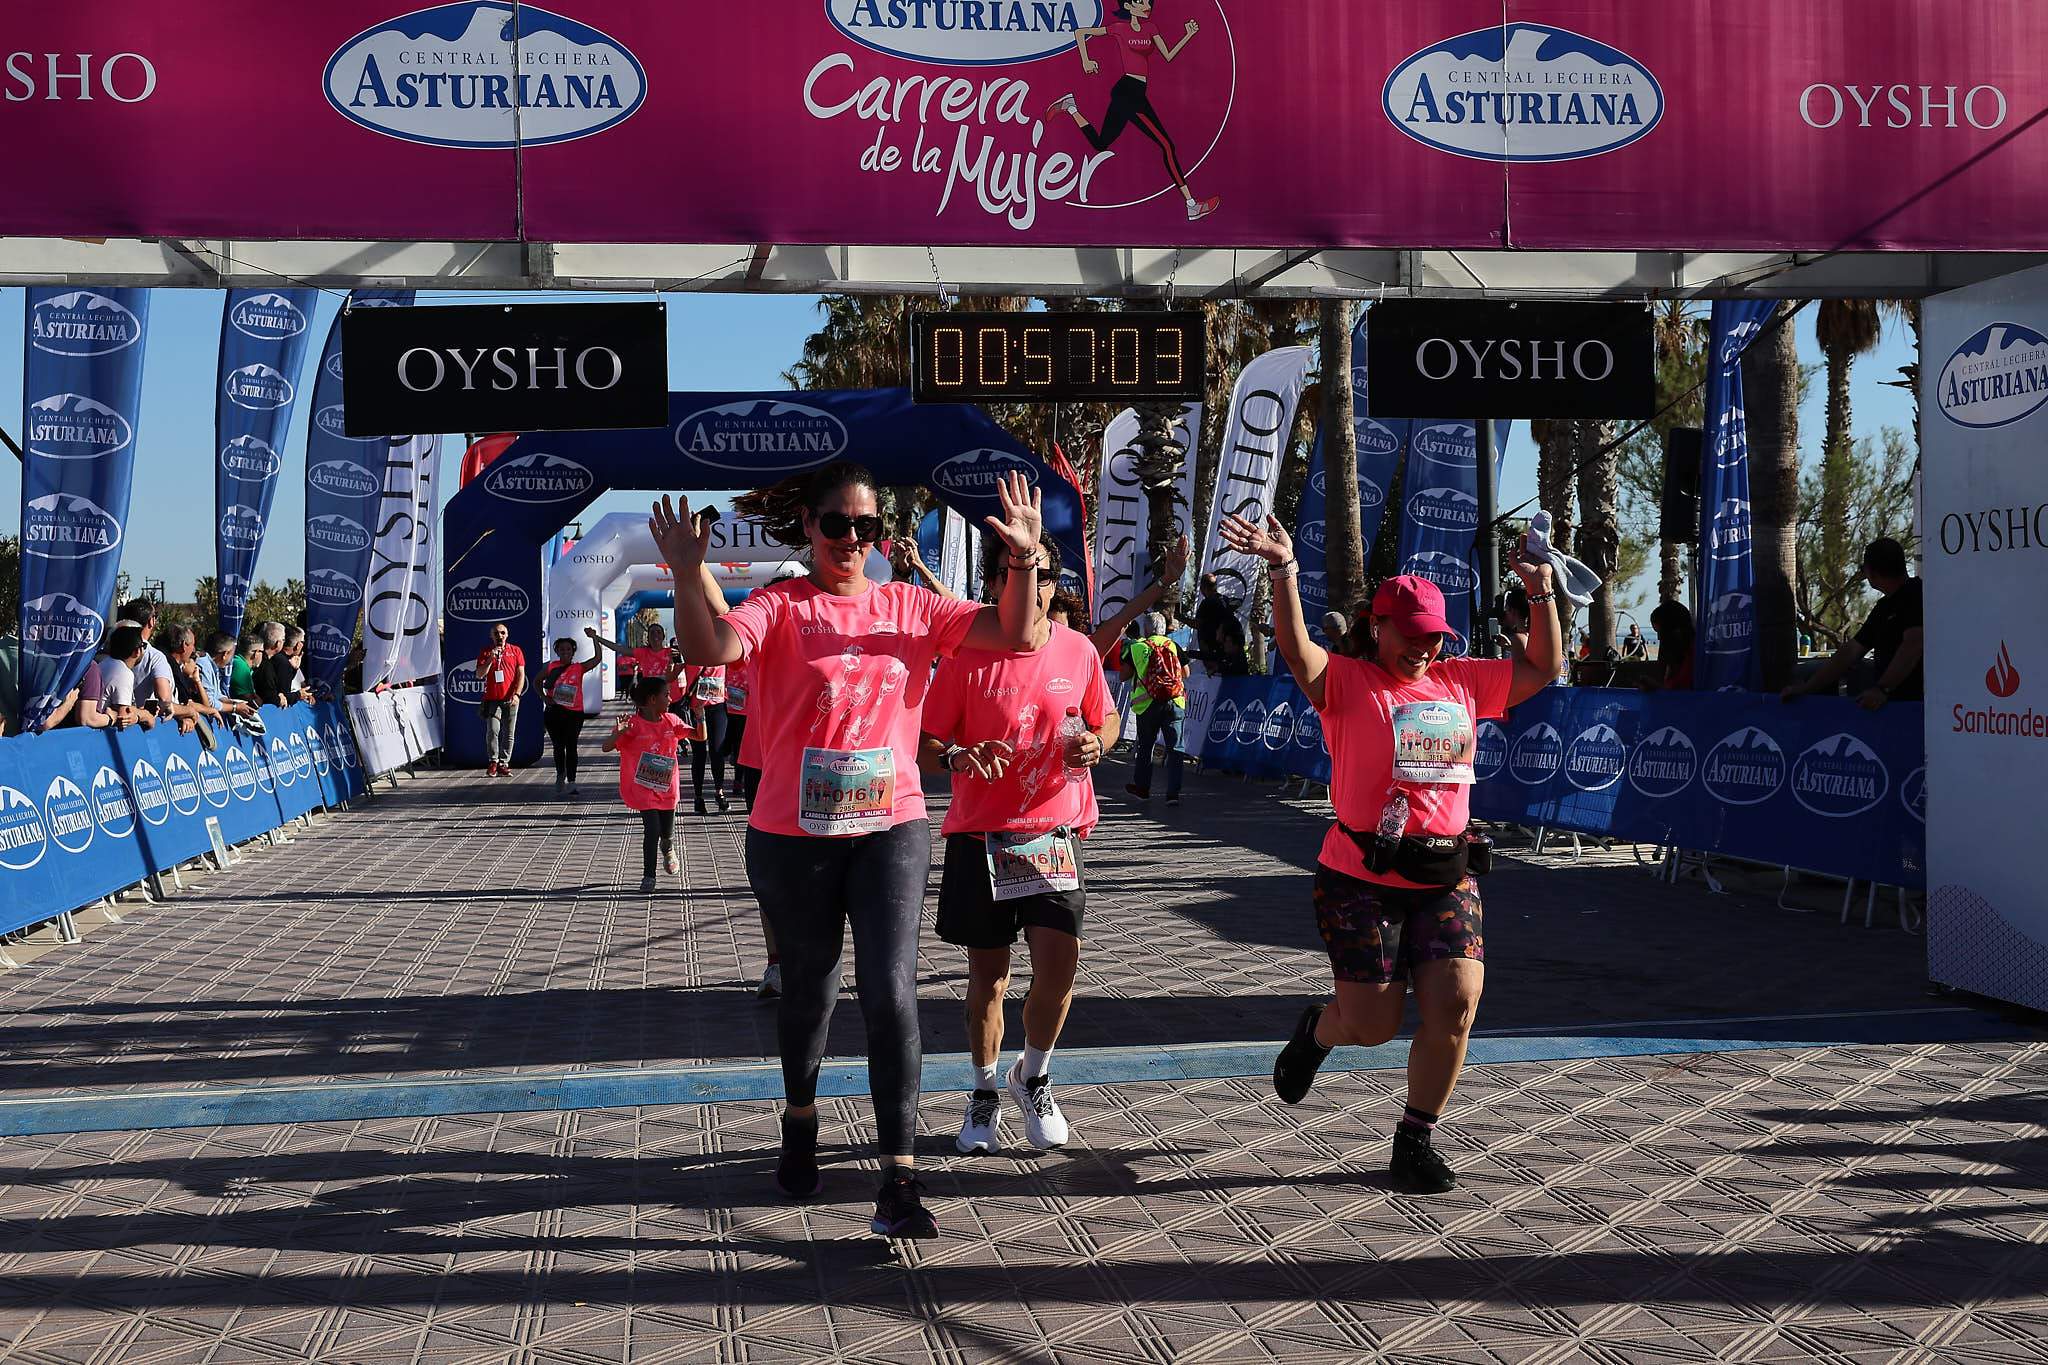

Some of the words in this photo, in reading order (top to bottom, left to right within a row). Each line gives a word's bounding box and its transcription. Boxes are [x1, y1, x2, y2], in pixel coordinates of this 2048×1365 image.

[848, 0, 1079, 32] ASTURIANA
[400, 51, 498, 65] CENTRAL
[5, 51, 157, 103] SHO
[349, 53, 623, 109] ASTURIANA
[803, 53, 1030, 125] Carrera
[1448, 71, 1535, 84] CENTRAL
[1544, 72, 1633, 85] LECHERA
[1405, 73, 1643, 125] ASTURIANA
[1799, 83, 2007, 130] OYSHO
[860, 126, 902, 172] de
[913, 127, 942, 173] la
[936, 119, 1115, 230] Mujer
[397, 346, 622, 392] OYSHO
[934, 328, 1183, 385] 00:57:03
[1415, 338, 1614, 381] OYSHO
[1962, 360, 2000, 375] CENTRAL
[2004, 349, 2046, 366] LECHERA
[1945, 364, 2048, 408] ASTURIANA
[688, 422, 836, 453] ASTURIANA
[714, 420, 769, 429] CENTRAL
[1420, 434, 1477, 459] ASTURIA
[313, 469, 373, 492] ASTURIANA
[490, 472, 585, 491] ASTURIANA
[1413, 499, 1479, 524] ASTURIAN
[1940, 503, 2048, 555] OYSHO
[573, 554, 614, 564] OYSHO
[450, 593, 524, 611] ASTURIANA
[555, 609, 594, 620] OYSHO
[1423, 737, 1451, 751] 016
[1568, 746, 1619, 775] ASTURIANA
[1632, 751, 1689, 780] ASTURIANA
[1707, 754, 1777, 787] ASTURIANA
[1796, 760, 1876, 799] ASTURIANA
[832, 788, 867, 803] 016
[50, 807, 92, 836] ASTURIANA
[809, 822, 839, 831] OYSHO
[1436, 839, 1454, 847] asics
